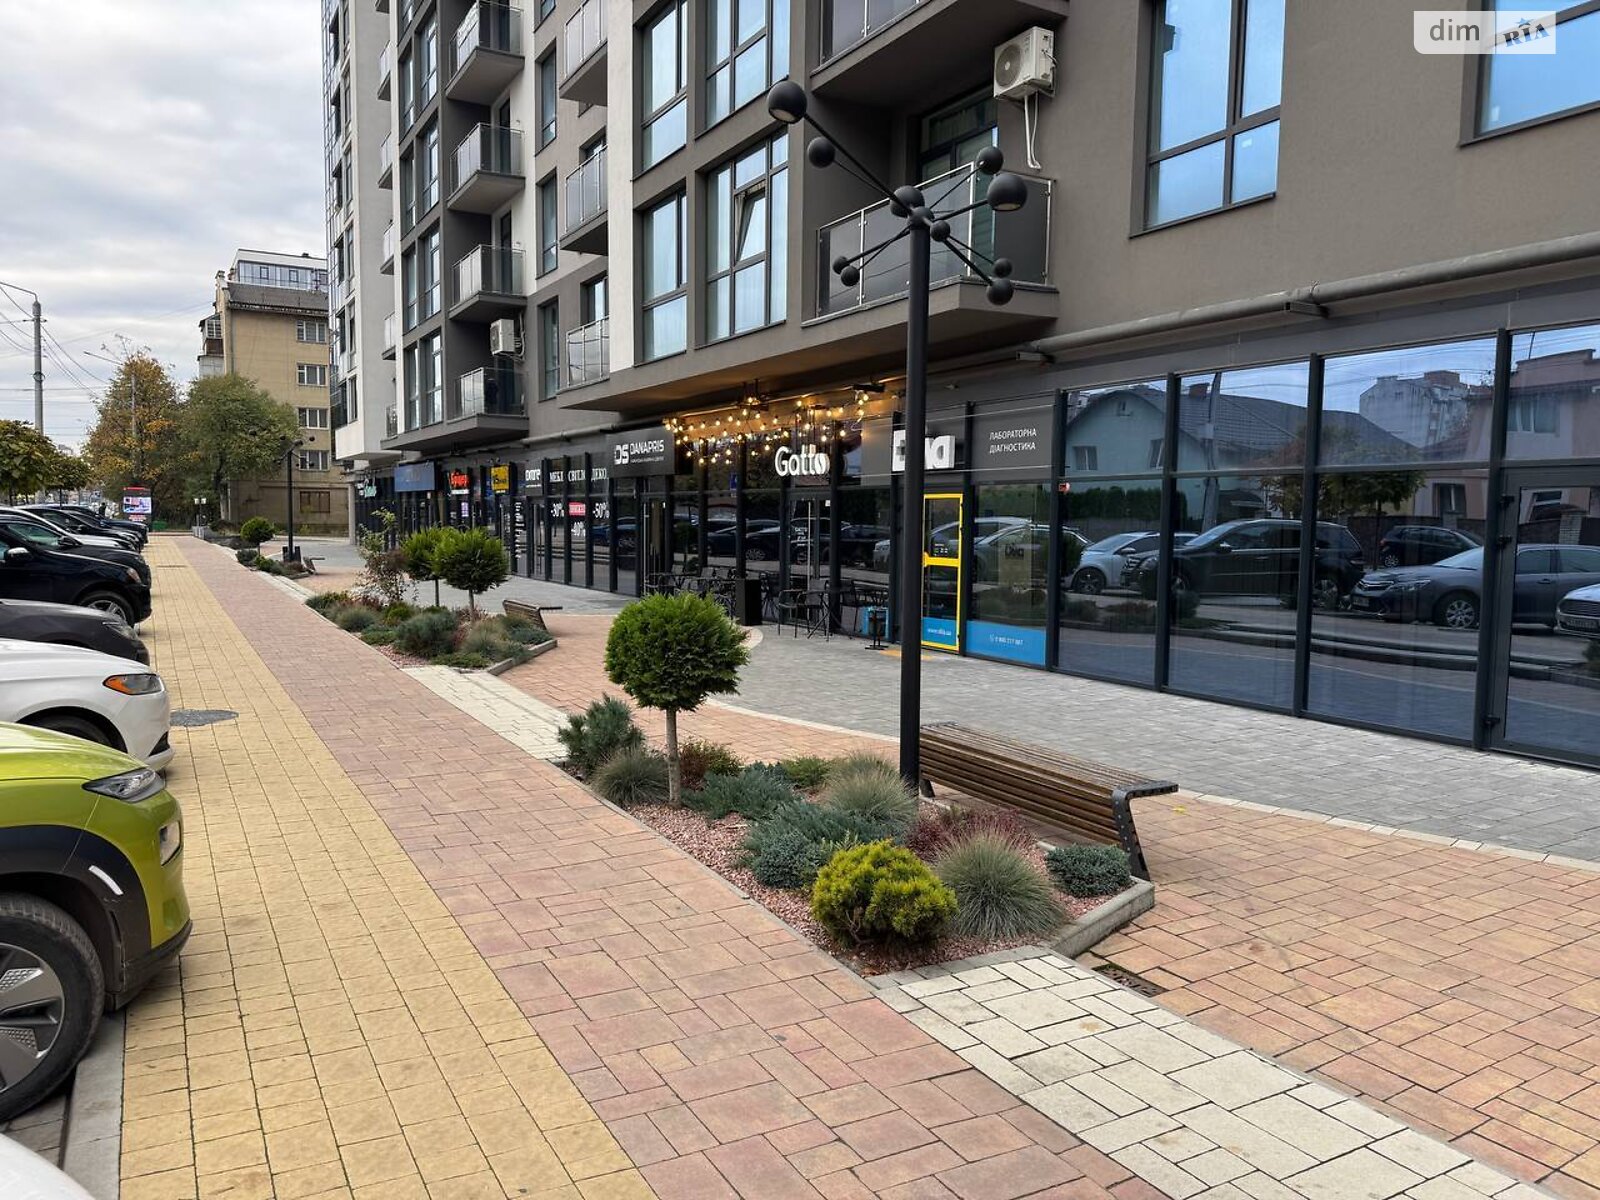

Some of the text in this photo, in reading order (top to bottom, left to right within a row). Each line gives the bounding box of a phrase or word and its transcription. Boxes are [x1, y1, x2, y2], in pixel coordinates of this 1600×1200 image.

[989, 428, 1037, 440] ЛАБОРАТОРНА
[630, 440, 664, 455] DANAPRIS
[989, 441, 1036, 454] ДІАГНОСТИКА
[775, 444, 829, 476] Gatto
